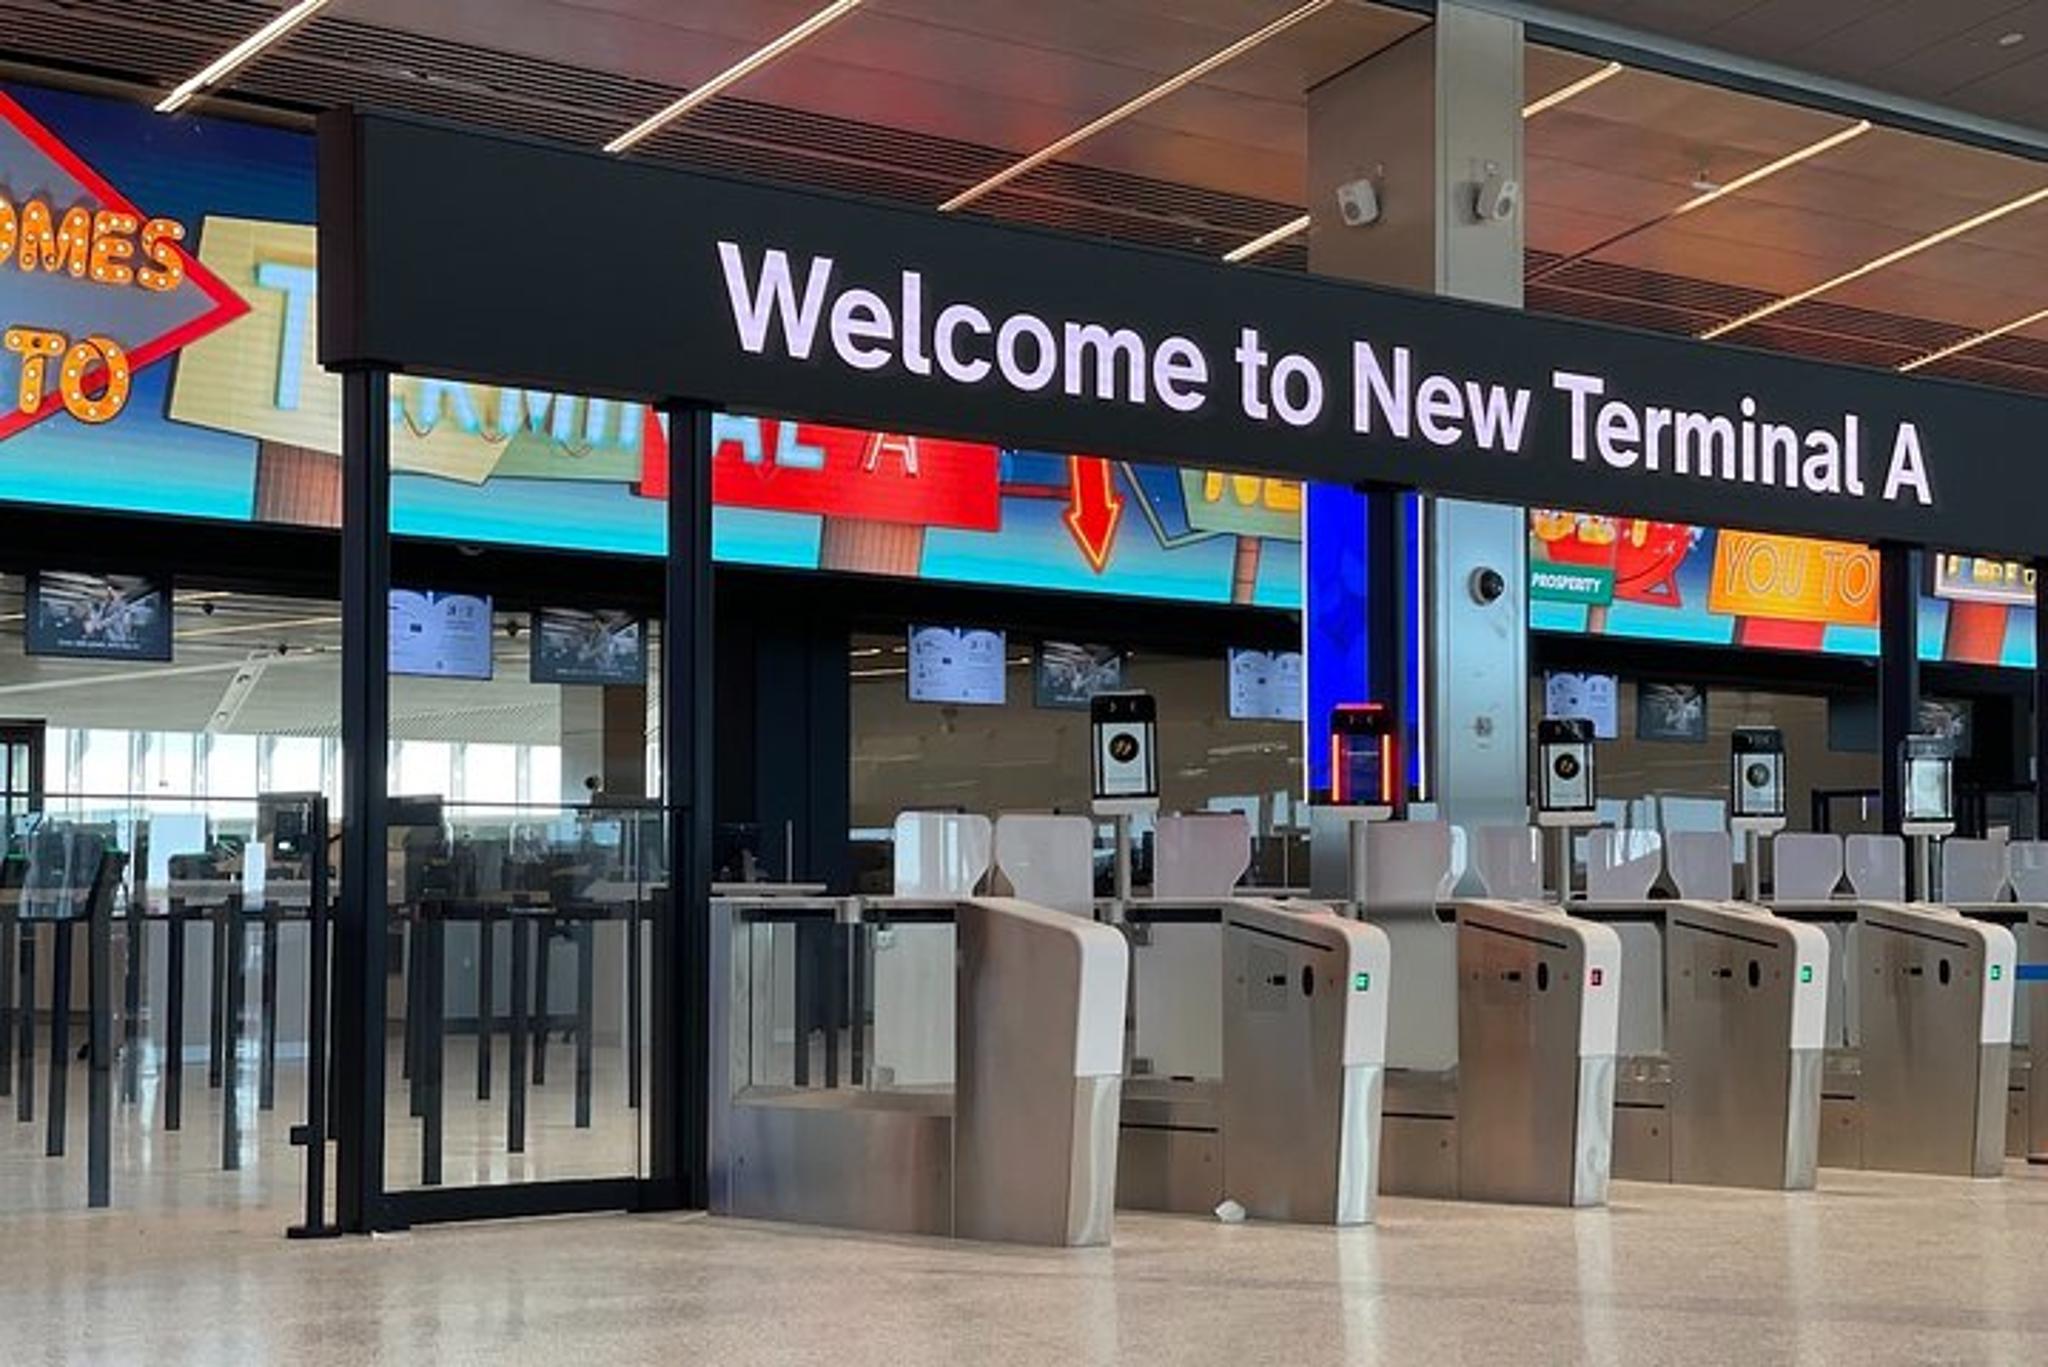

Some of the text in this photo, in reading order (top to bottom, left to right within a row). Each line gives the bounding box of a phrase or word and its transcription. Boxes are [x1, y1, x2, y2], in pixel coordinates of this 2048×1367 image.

[4, 327, 131, 424] TO
[716, 239, 1934, 505] Welcome to New Terminal A
[1531, 571, 1602, 595] PROSPERITY
[1725, 536, 1808, 600] YOU
[1821, 545, 1874, 608] TO
